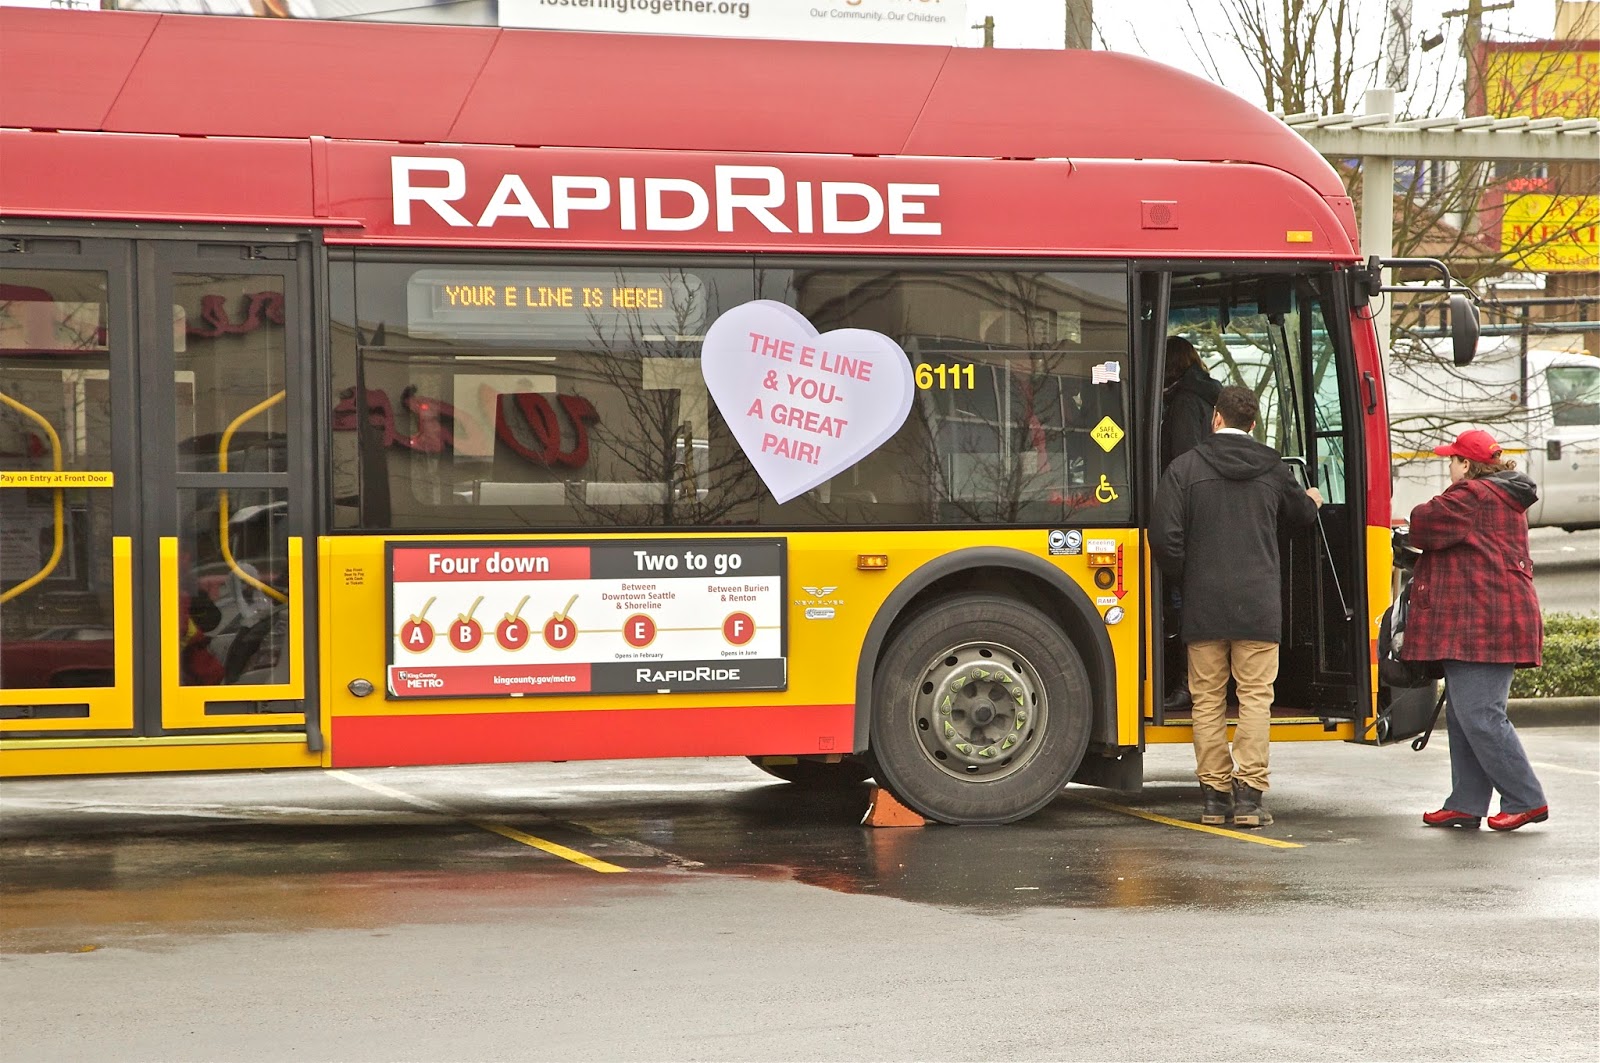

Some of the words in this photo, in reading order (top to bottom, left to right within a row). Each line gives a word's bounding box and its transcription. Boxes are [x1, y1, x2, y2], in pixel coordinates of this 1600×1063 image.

[809, 8, 827, 18] Our
[907, 12, 946, 23] Children
[1506, 177, 1548, 191] OPEN
[390, 156, 942, 236] RAPIDRIDE
[446, 285, 496, 306] YOUR
[505, 286, 516, 306] E
[526, 286, 572, 307] LINE
[582, 287, 603, 307] IS
[612, 287, 663, 308] HERE!
[749, 332, 795, 362] THE
[800, 346, 816, 367] E
[820, 351, 873, 382] LINE
[915, 363, 975, 390] 6111
[763, 369, 779, 392] &
[786, 374, 843, 404] YOU-
[747, 398, 763, 419] A
[770, 403, 848, 439] GREAT
[761, 433, 821, 465] PAIR!
[0, 474, 14, 483] Pay
[30, 474, 51, 483] Entry
[64, 474, 85, 482] Front
[88, 474, 107, 482] Door
[428, 553, 480, 574] Four
[486, 551, 549, 573] down
[634, 550, 679, 571] Two
[684, 551, 708, 570] to
[714, 553, 742, 575] go
[602, 592, 646, 600] Downtown
[648, 591, 676, 600] Seattle
[621, 583, 656, 591] Between
[708, 584, 742, 593] Between
[744, 584, 769, 592] Burien
[616, 602, 622, 610] &
[624, 601, 662, 610] Shoreline
[720, 594, 727, 602] &
[729, 593, 757, 602] Renton
[409, 627, 424, 644] A
[459, 626, 472, 643] B
[505, 625, 518, 642] C
[553, 624, 568, 641] D
[635, 622, 645, 639] E
[734, 620, 744, 637] F
[640, 651, 664, 659] February
[407, 679, 444, 689] METRO
[494, 675, 576, 685] kingcounty.gov/metro
